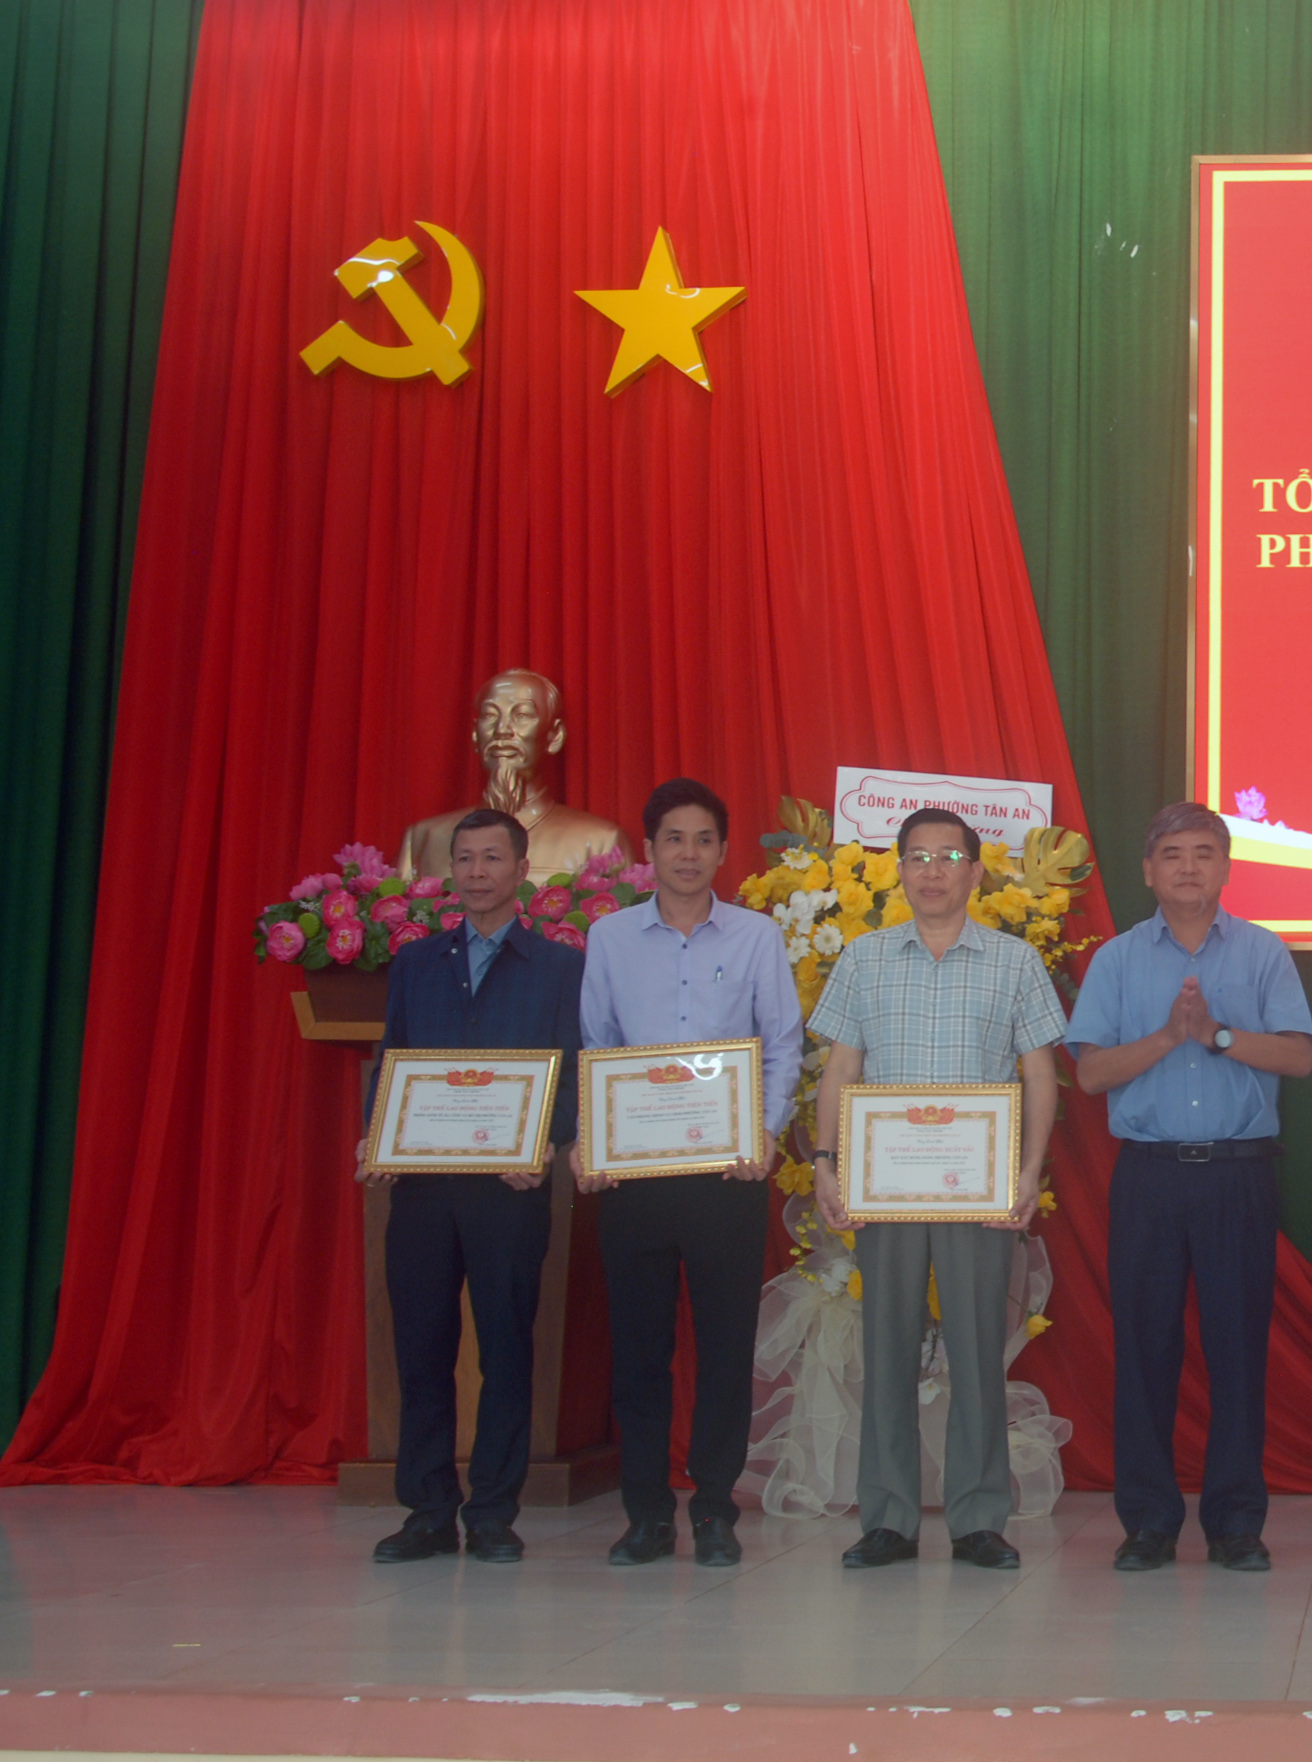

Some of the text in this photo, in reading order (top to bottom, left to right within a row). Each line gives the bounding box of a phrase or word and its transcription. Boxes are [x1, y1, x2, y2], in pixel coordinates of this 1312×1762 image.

[858, 793, 1031, 820] CÔNG AN PHƯỜNG TÂN AN
